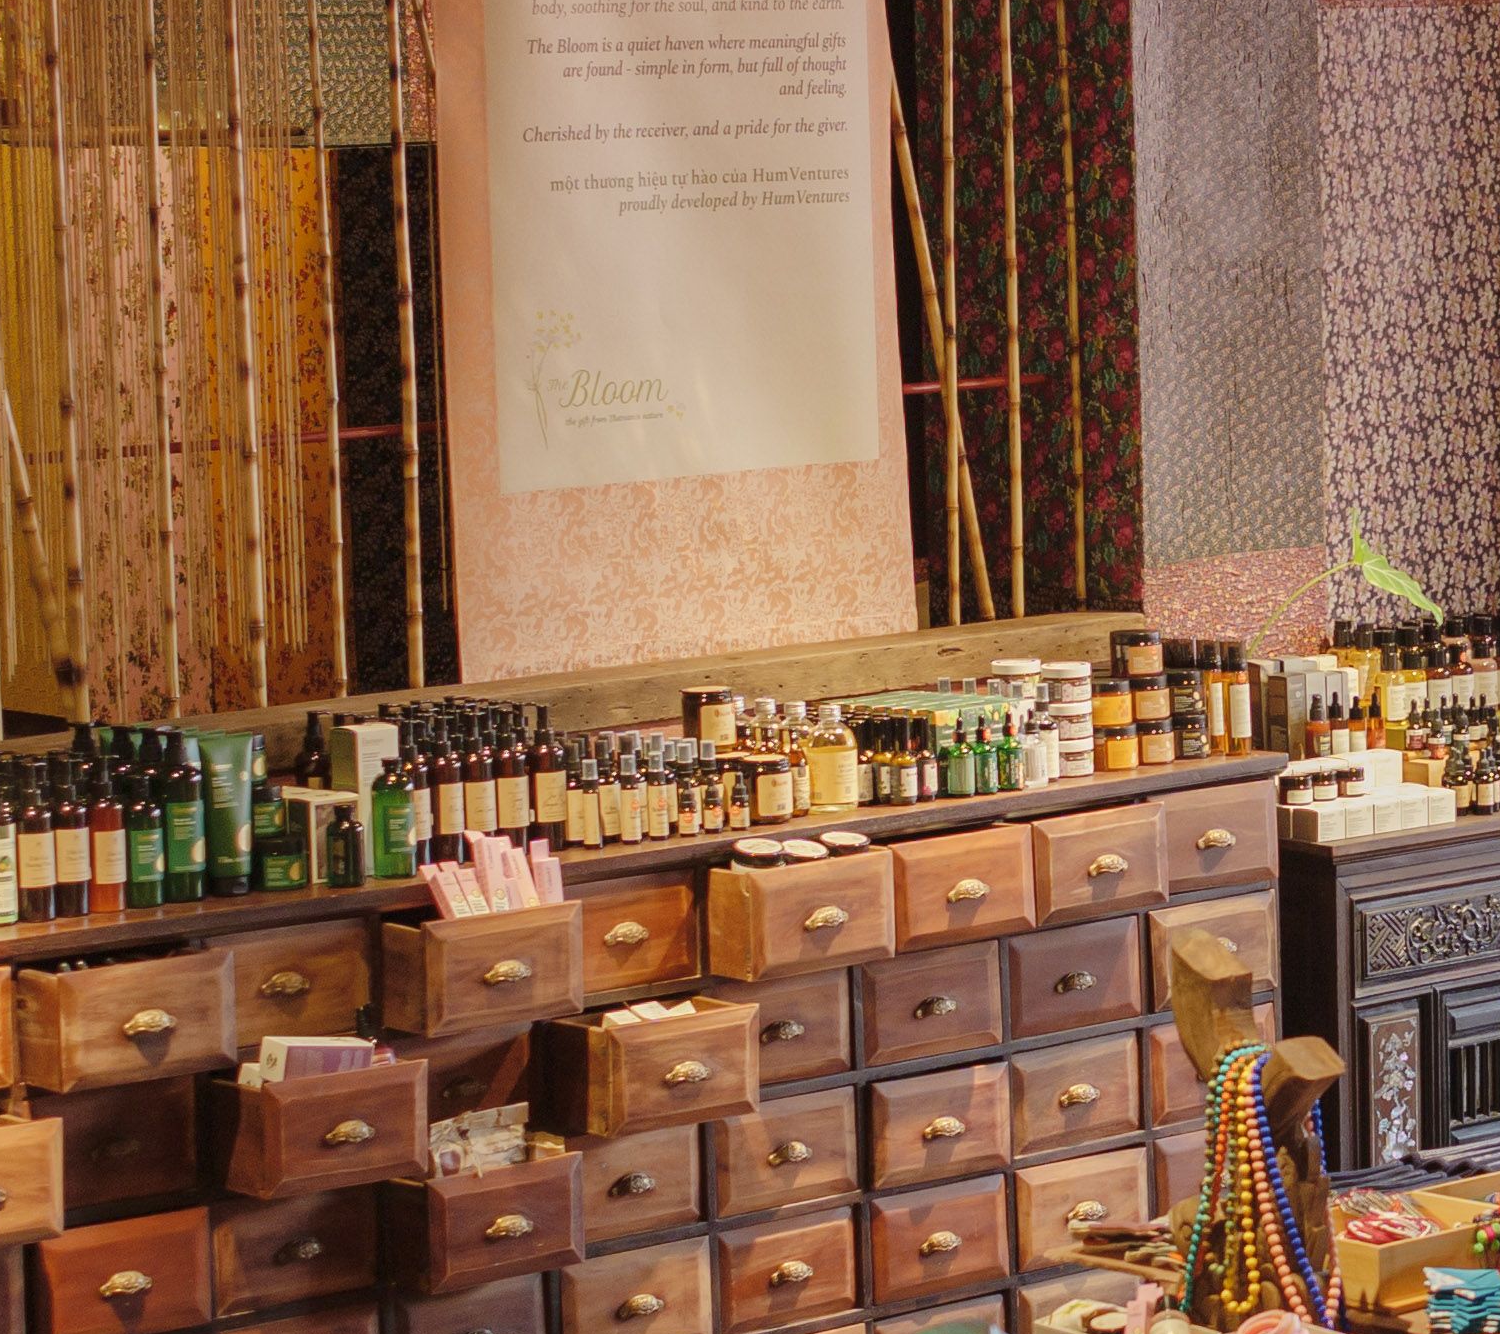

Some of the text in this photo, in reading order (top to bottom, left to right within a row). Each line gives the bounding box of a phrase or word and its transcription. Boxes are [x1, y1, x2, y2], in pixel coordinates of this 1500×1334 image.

[773, 0, 785, 11] to
[527, 32, 846, 56] The Bloom is a quiet haven where meaningful gifts
[563, 67, 583, 78] are
[584, 60, 623, 82] found
[635, 59, 679, 80] simple
[682, 59, 695, 74] in
[737, 57, 759, 73] but
[759, 56, 783, 77] full
[787, 56, 801, 76] of
[803, 55, 847, 76] thought
[779, 80, 804, 96] and
[523, 124, 591, 143] Cherished
[595, 124, 610, 144] by
[613, 123, 632, 139] the
[692, 120, 719, 136] and
[723, 125, 731, 135] a
[734, 119, 769, 139] pride
[771, 118, 792, 138] for
[795, 117, 815, 133] the
[550, 175, 580, 194] một
[584, 174, 634, 192] thương
[638, 172, 667, 190] hiệu
[672, 173, 689, 189] tự
[692, 169, 718, 185] hào
[722, 168, 747, 184] của
[619, 194, 667, 217] proudly
[671, 191, 738, 212] developed
[742, 191, 758, 210] by
[558, 369, 669, 408] Bloom
